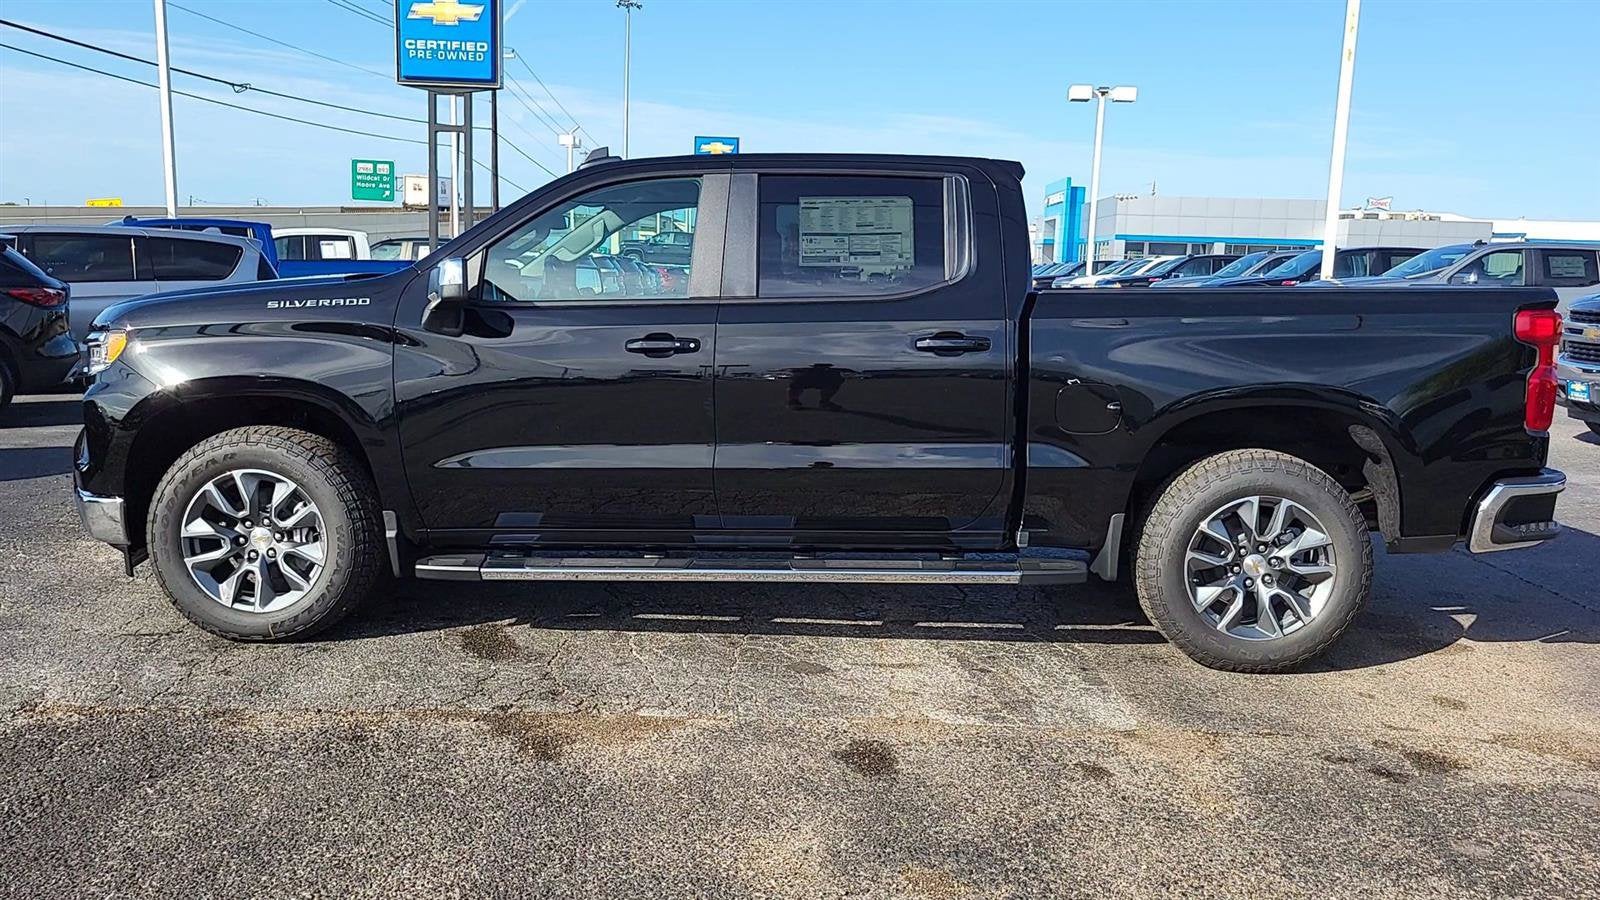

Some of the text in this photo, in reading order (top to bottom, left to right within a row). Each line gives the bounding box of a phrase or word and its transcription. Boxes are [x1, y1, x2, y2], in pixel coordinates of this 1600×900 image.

[405, 39, 488, 52] CERTIFIED
[409, 50, 484, 61] PRE-OWNED
[356, 174, 380, 182] Wildcat
[266, 298, 371, 309] SILVERADO
